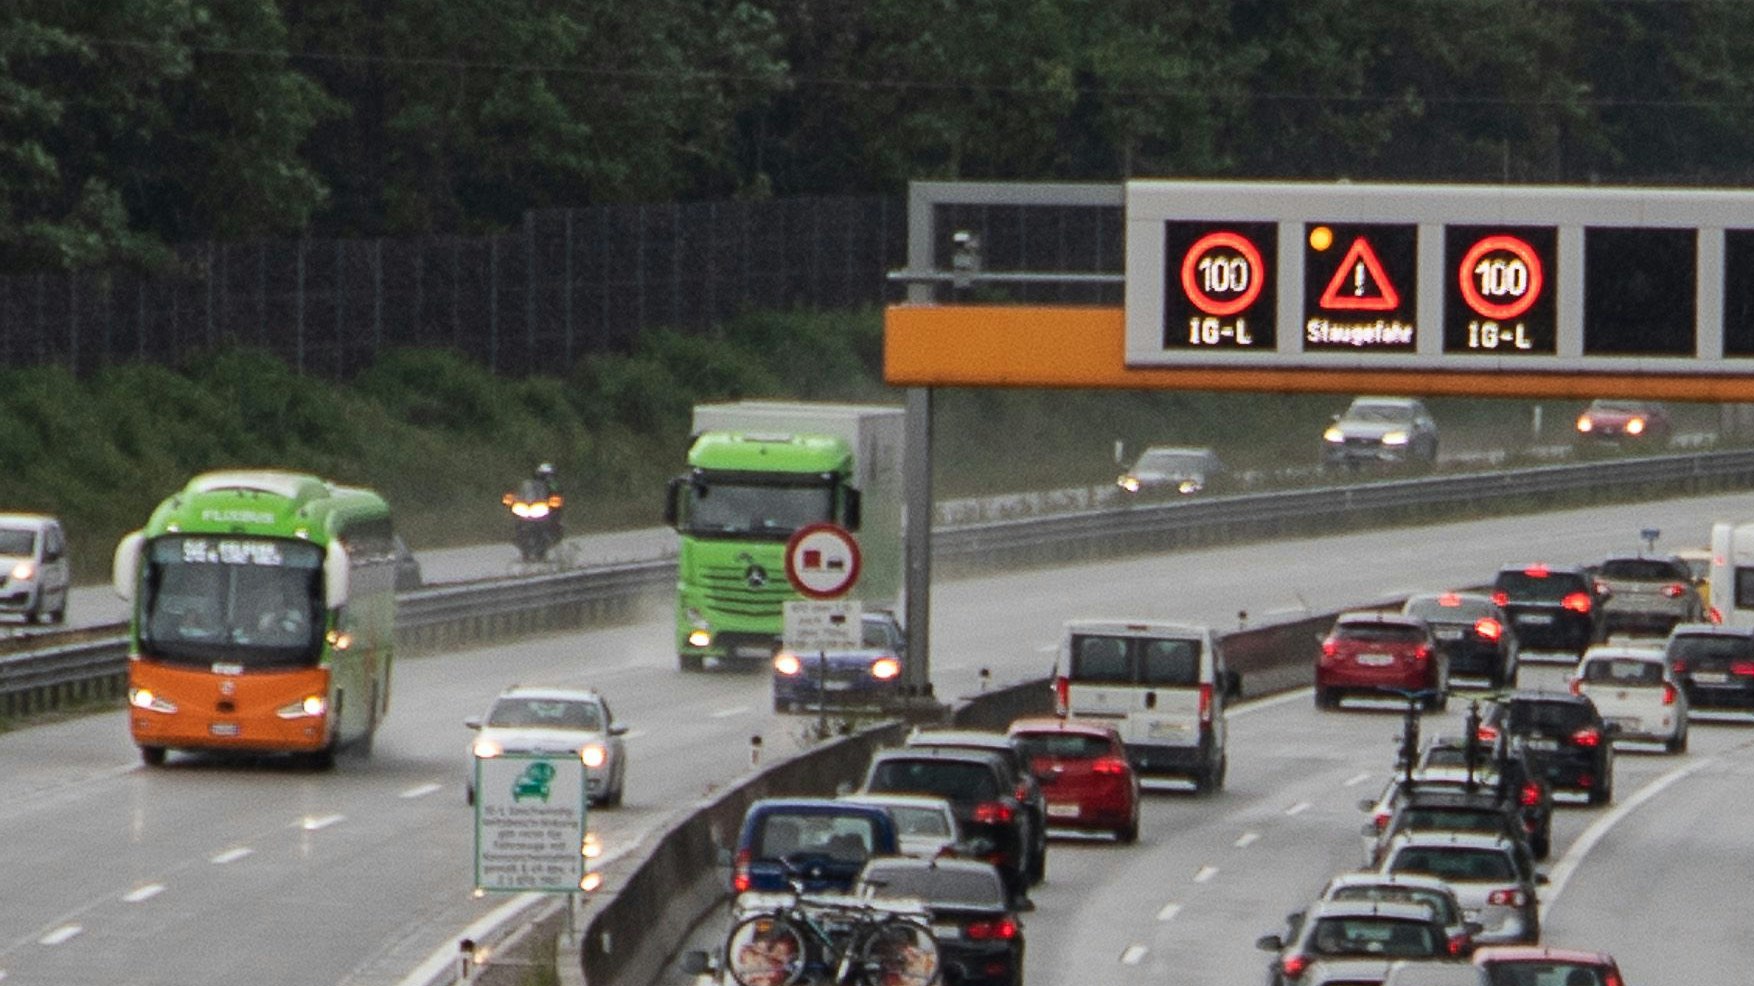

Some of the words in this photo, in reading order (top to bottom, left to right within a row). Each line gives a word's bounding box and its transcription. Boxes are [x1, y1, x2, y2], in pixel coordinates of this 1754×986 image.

[1198, 257, 1249, 293] 100
[1474, 259, 1528, 296] 100
[1189, 317, 1253, 345] IG-L
[1306, 319, 1413, 346] Staugefahr
[1468, 321, 1533, 349] IG-L
